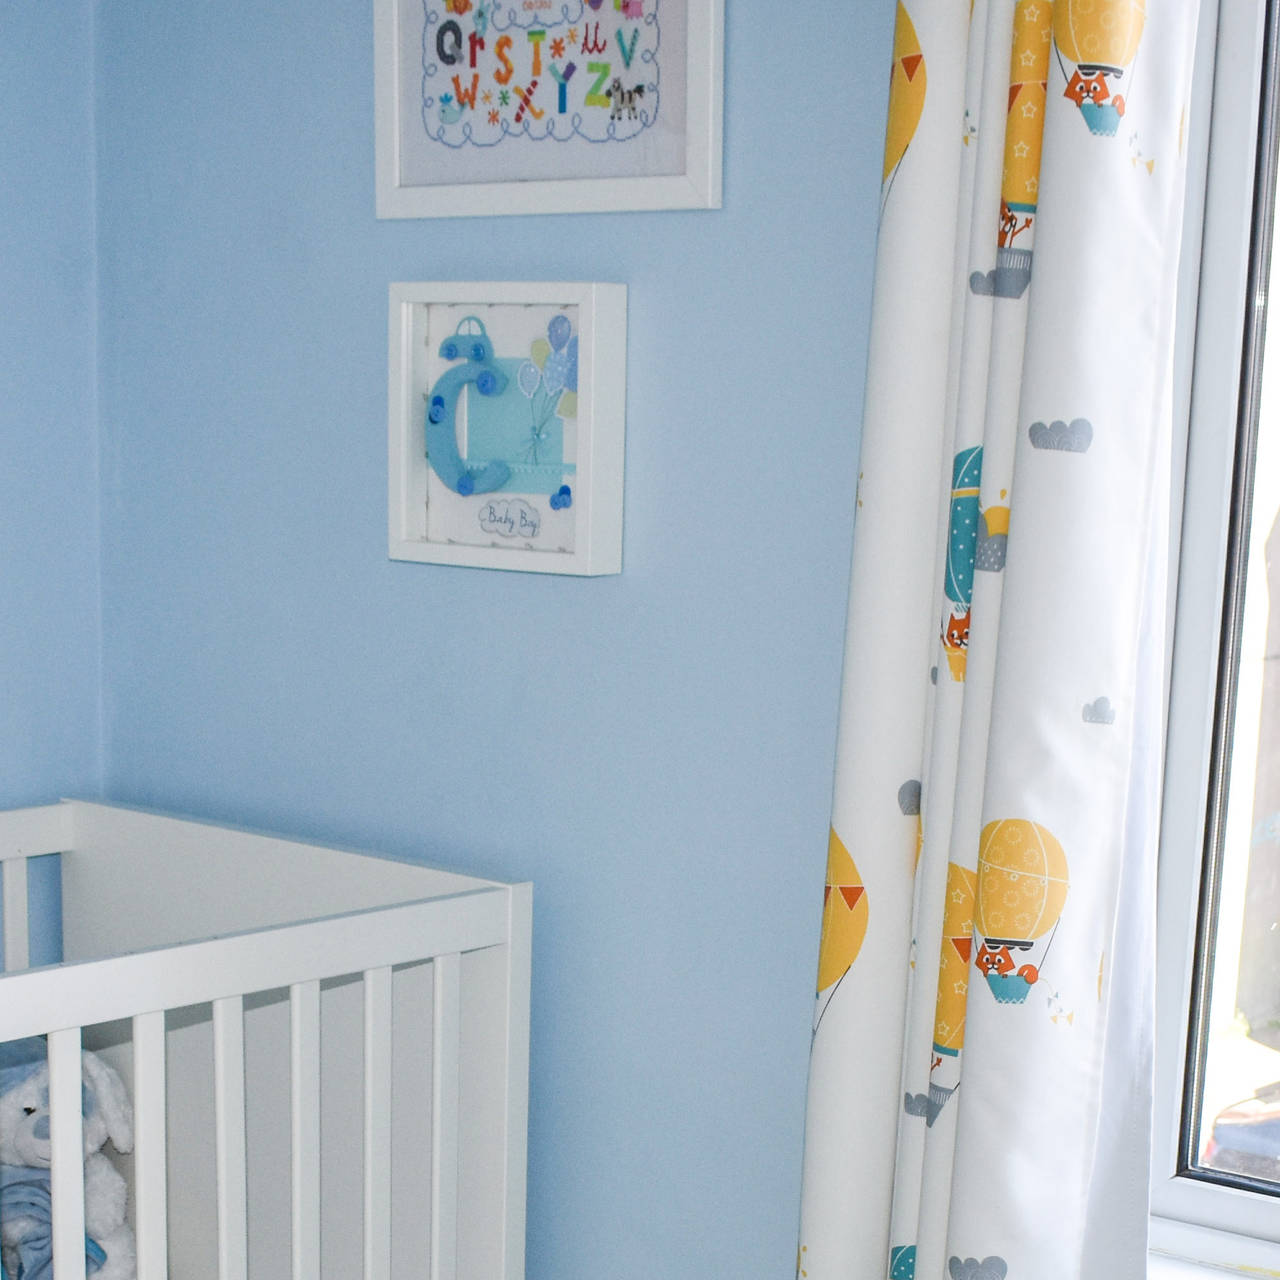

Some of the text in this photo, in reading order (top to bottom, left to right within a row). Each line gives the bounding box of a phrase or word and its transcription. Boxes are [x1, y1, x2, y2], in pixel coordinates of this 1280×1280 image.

[493, 35, 514, 85] S
[527, 29, 546, 77] T
[513, 80, 544, 122] X
[548, 62, 576, 114] Y
[585, 62, 611, 108] Z
[488, 504, 537, 537] Baby Boy
